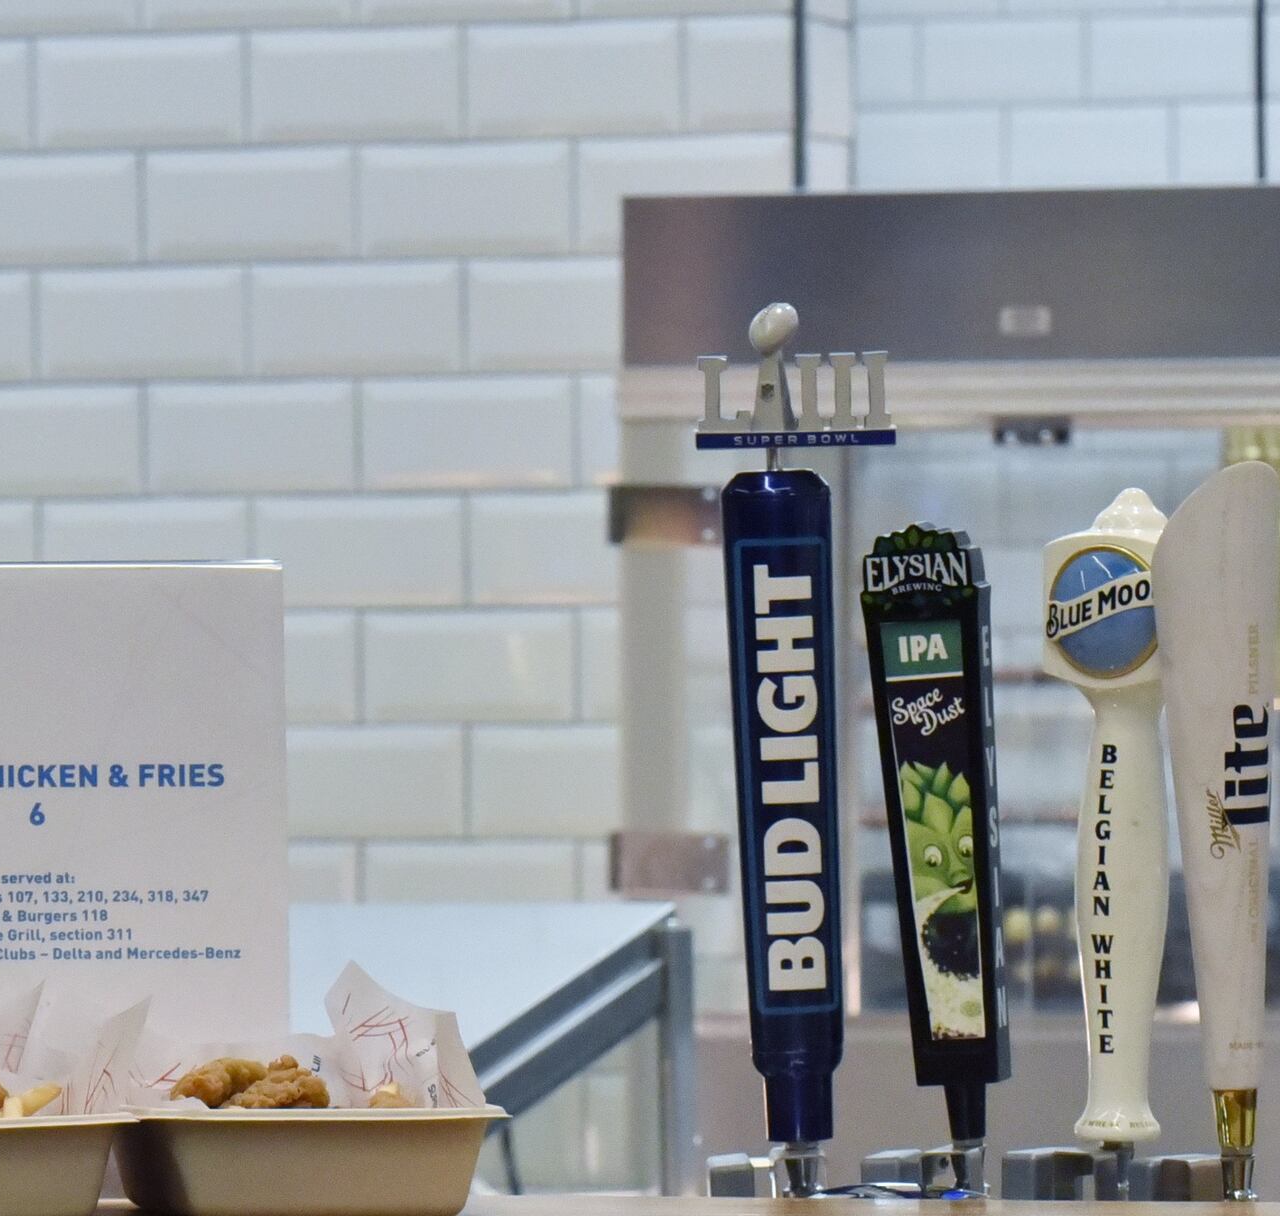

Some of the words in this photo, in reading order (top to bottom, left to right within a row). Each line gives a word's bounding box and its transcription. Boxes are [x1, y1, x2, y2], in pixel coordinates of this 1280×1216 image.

[697, 350, 892, 432] LIII
[733, 434, 798, 446] SUPER
[807, 432, 859, 445] BOWL
[865, 551, 968, 592] ELYSIAN
[891, 582, 943, 596] BREWING
[1045, 598, 1093, 639] BLUE
[1097, 577, 1151, 617] MOO
[897, 633, 949, 663] IPA
[752, 563, 821, 805] LIGHT
[891, 687, 944, 726] Space
[920, 696, 966, 737] Dust
[108, 763, 129, 788] &
[138, 763, 225, 788] FRIES
[1223, 702, 1271, 826] lite
[29, 802, 46, 827] 6
[981, 625, 1008, 1029] ELYSIAN
[1093, 744, 1118, 917] BELGIAN
[1209, 789, 1241, 860] Miller
[0, 871, 52, 885] served
[55, 872, 75, 885] at:
[7, 890, 38, 905] 107,
[42, 890, 73, 905] 133,
[77, 890, 108, 905] 210,
[112, 889, 144, 905] 234,
[147, 889, 178, 904] 318,
[182, 889, 209, 903] 347
[1, 909, 13, 923] &
[17, 909, 78, 925] Burgers
[82, 908, 108, 922] 118
[763, 817, 827, 992] BUD
[7, 928, 46, 944] Grill,
[49, 928, 103, 941] section
[106, 927, 132, 941] 311
[52, 947, 92, 961] Delta
[95, 947, 123, 960] and
[126, 946, 241, 960] Mercedes-Benz
[1091, 934, 1114, 1054] WHITE
